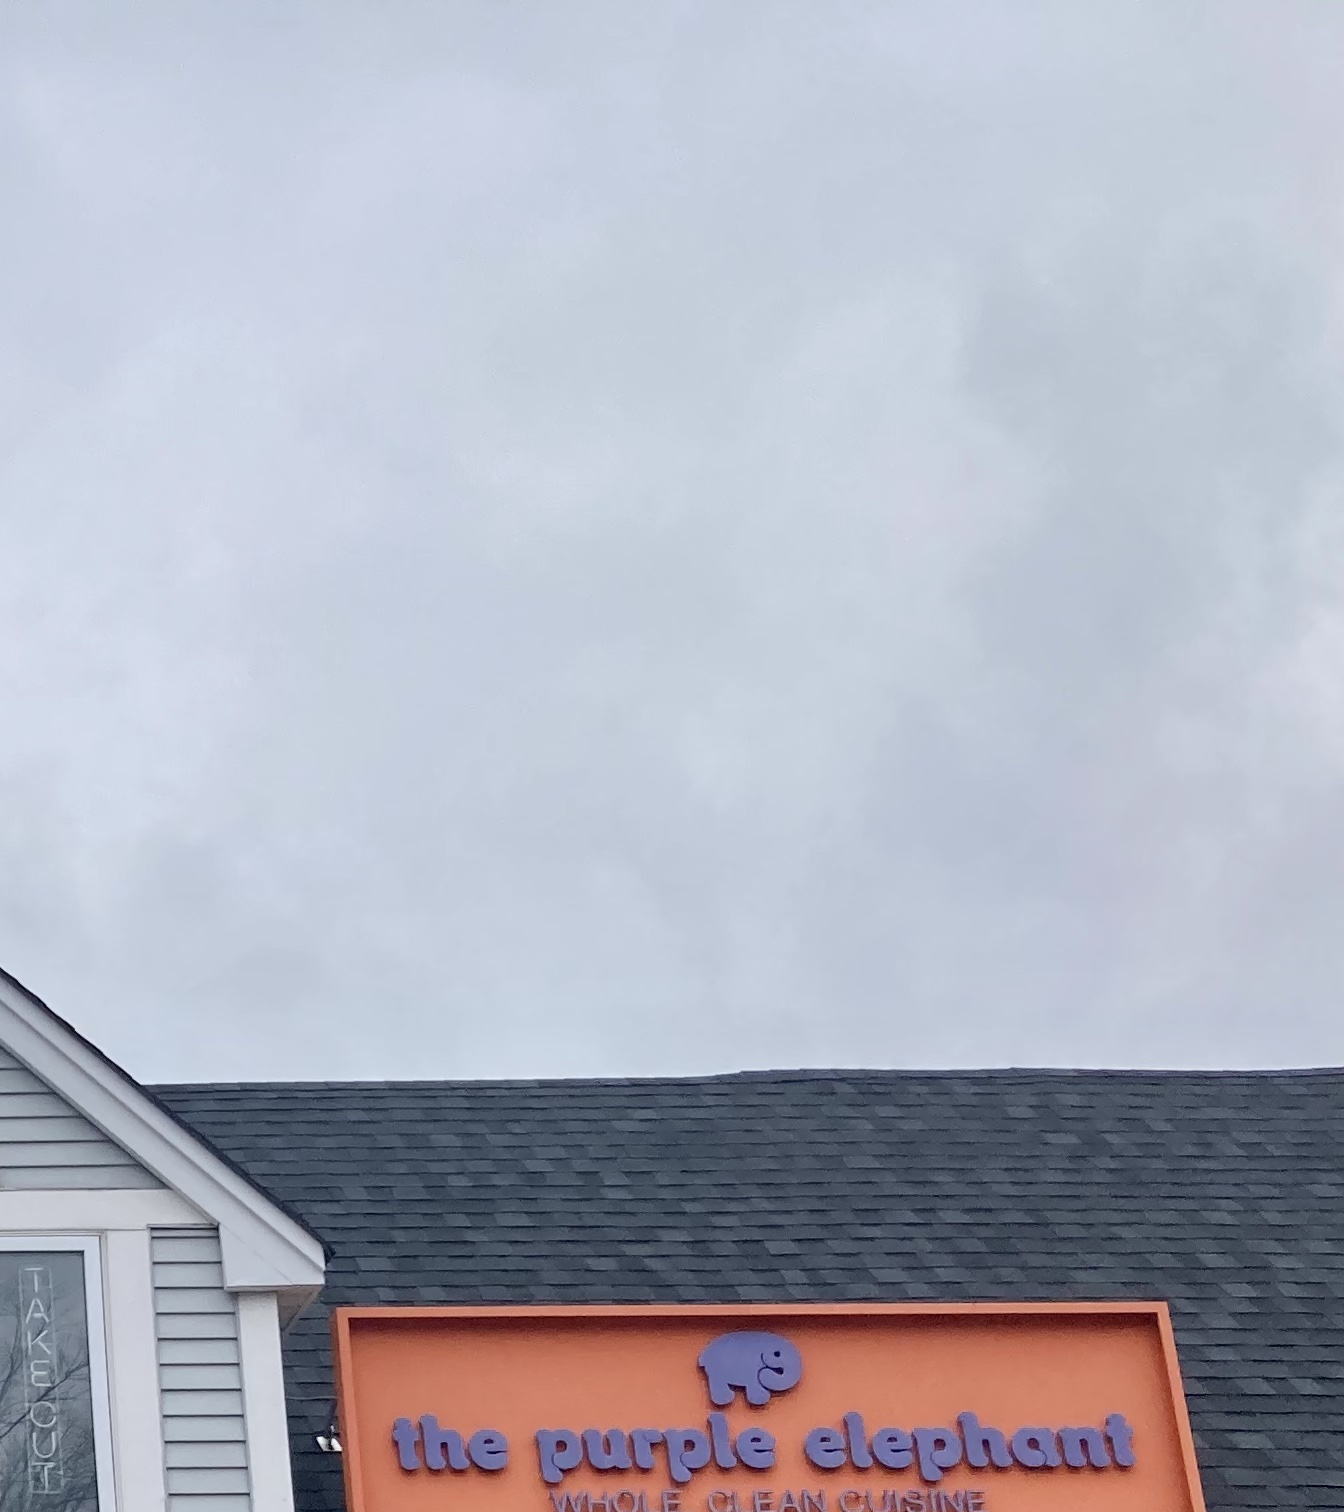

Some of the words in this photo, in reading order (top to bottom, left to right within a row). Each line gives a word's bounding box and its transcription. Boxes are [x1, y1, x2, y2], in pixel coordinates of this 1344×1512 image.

[392, 1412, 508, 1471] the
[535, 1411, 776, 1484] purple
[804, 1411, 1137, 1482] elephant
